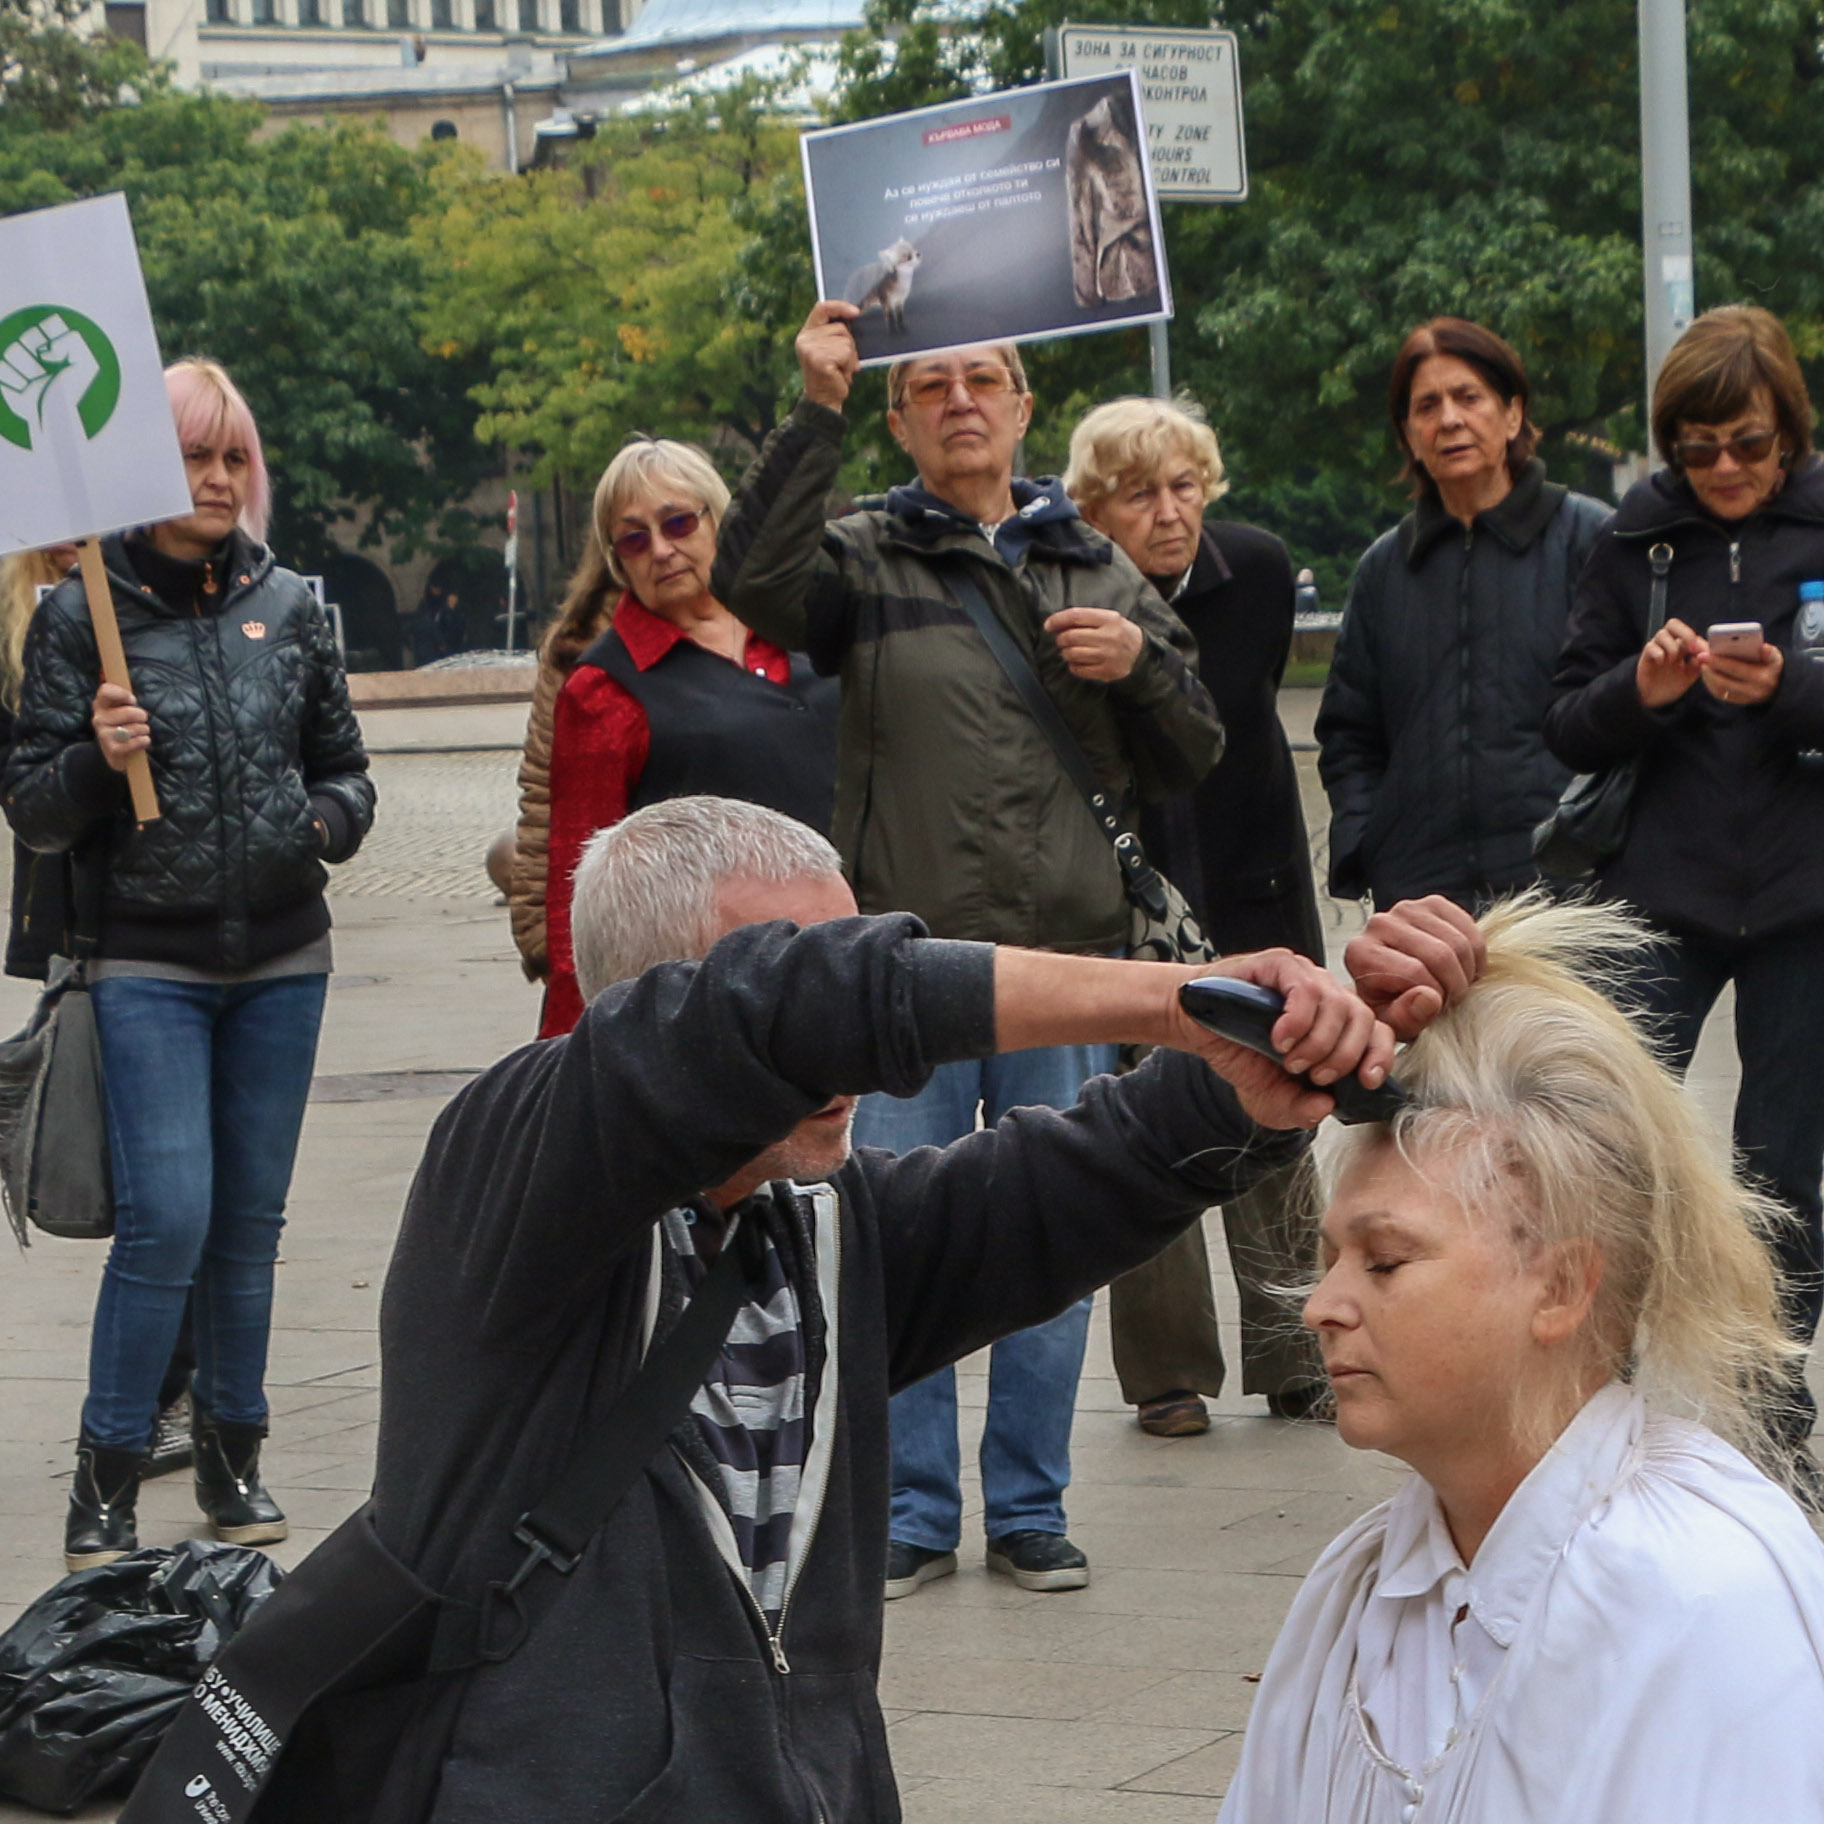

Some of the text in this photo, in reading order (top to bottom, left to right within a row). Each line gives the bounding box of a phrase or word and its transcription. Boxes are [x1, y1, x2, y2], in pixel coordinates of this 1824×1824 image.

[1074, 40, 1223, 61] ЗОНА ЗА СИГУРНОСТ
[1142, 64, 1188, 81] ЧАСОВ
[1142, 86, 1207, 102] КОНТРОЛ
[1149, 124, 1212, 141] TY ZONE
[884, 187, 899, 199] Аз
[901, 186, 916, 195] се
[918, 176, 961, 194] нуждая
[964, 173, 977, 183] от
[1045, 157, 1061, 169] си
[1015, 178, 1028, 188] ти
[904, 213, 919, 225] се
[978, 200, 990, 210] от
